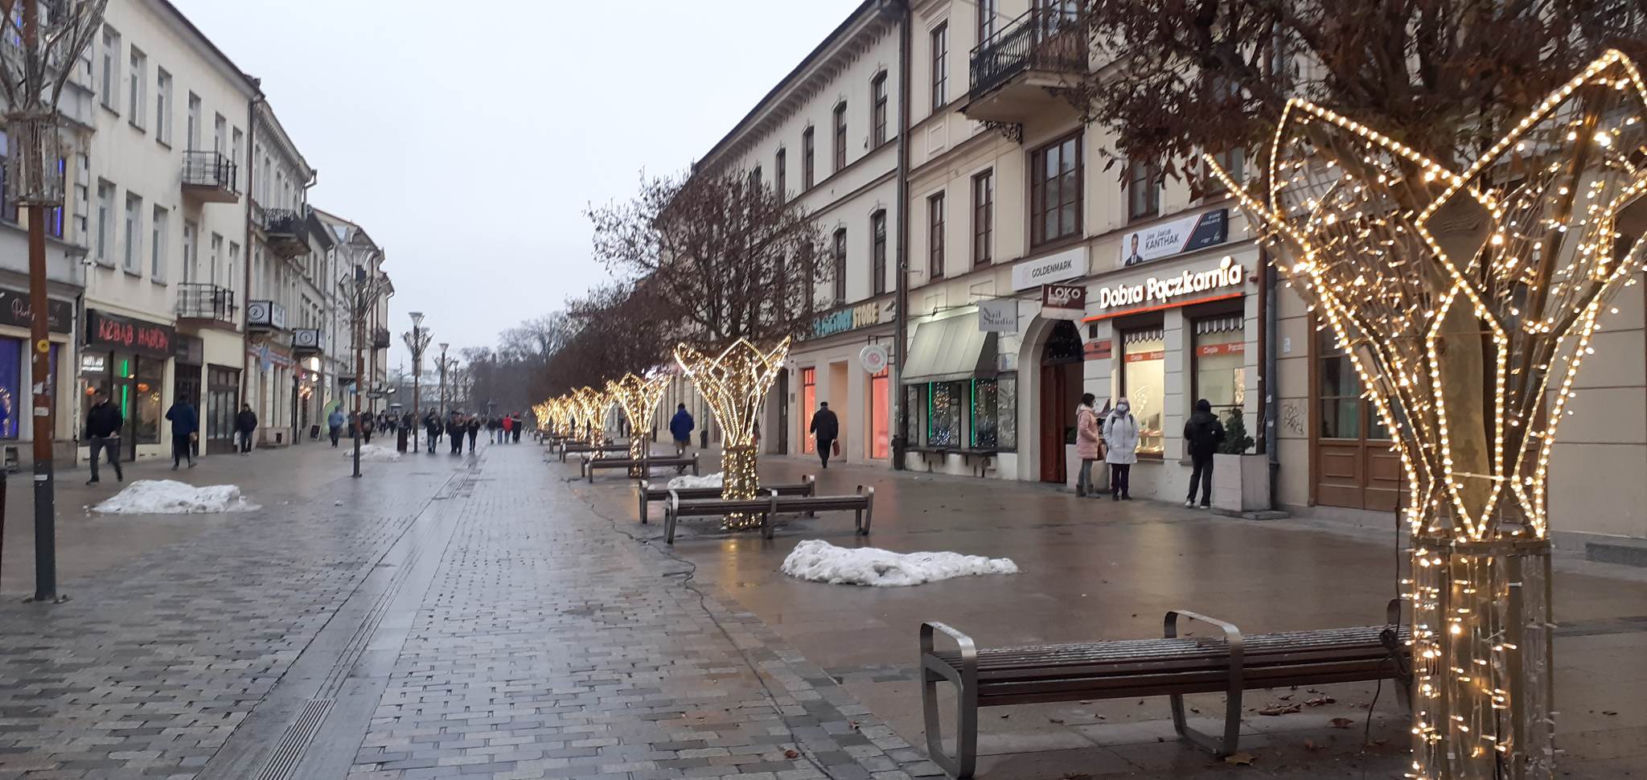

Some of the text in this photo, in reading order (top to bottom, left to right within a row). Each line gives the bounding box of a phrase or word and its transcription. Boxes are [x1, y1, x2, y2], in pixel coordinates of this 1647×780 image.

[1145, 234, 1180, 250] KANTHAK
[1031, 259, 1073, 279] GOLDENMARK
[1048, 286, 1081, 299] LOKO
[1100, 255, 1242, 309] Dobra Pączkarnia
[852, 302, 880, 329] STORE
[99, 317, 134, 347] KEBAB
